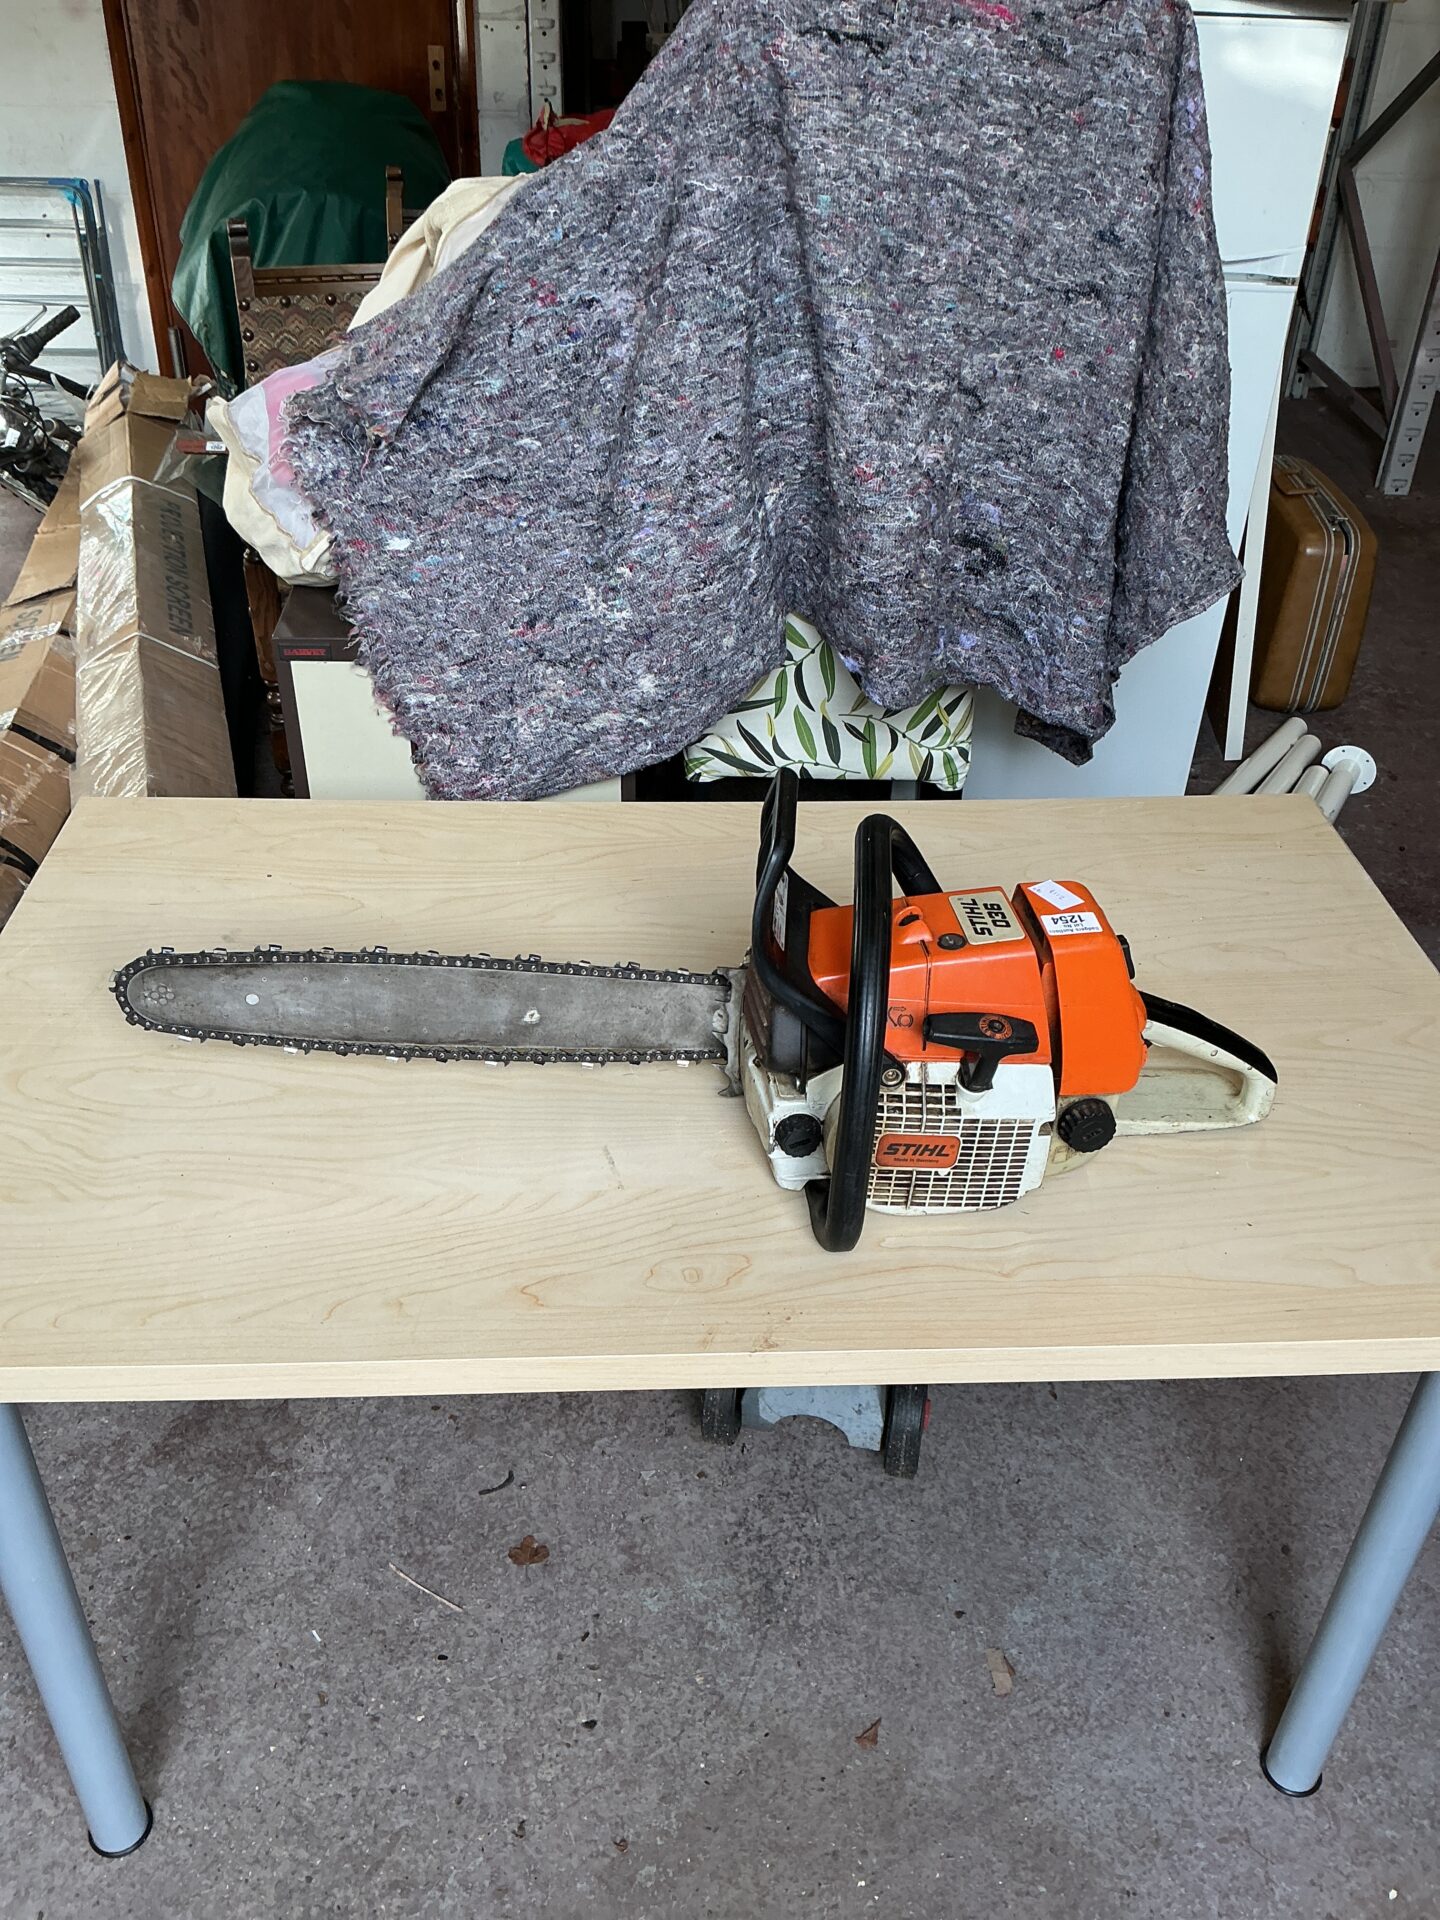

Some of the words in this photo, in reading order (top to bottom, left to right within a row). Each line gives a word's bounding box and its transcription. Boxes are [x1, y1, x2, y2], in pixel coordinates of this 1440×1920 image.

[165, 575, 193, 637] SCREEN
[960, 898, 993, 936] STIHL
[982, 903, 1012, 928] 036
[1051, 914, 1085, 925] 1254
[883, 1142, 950, 1157] STIHL
